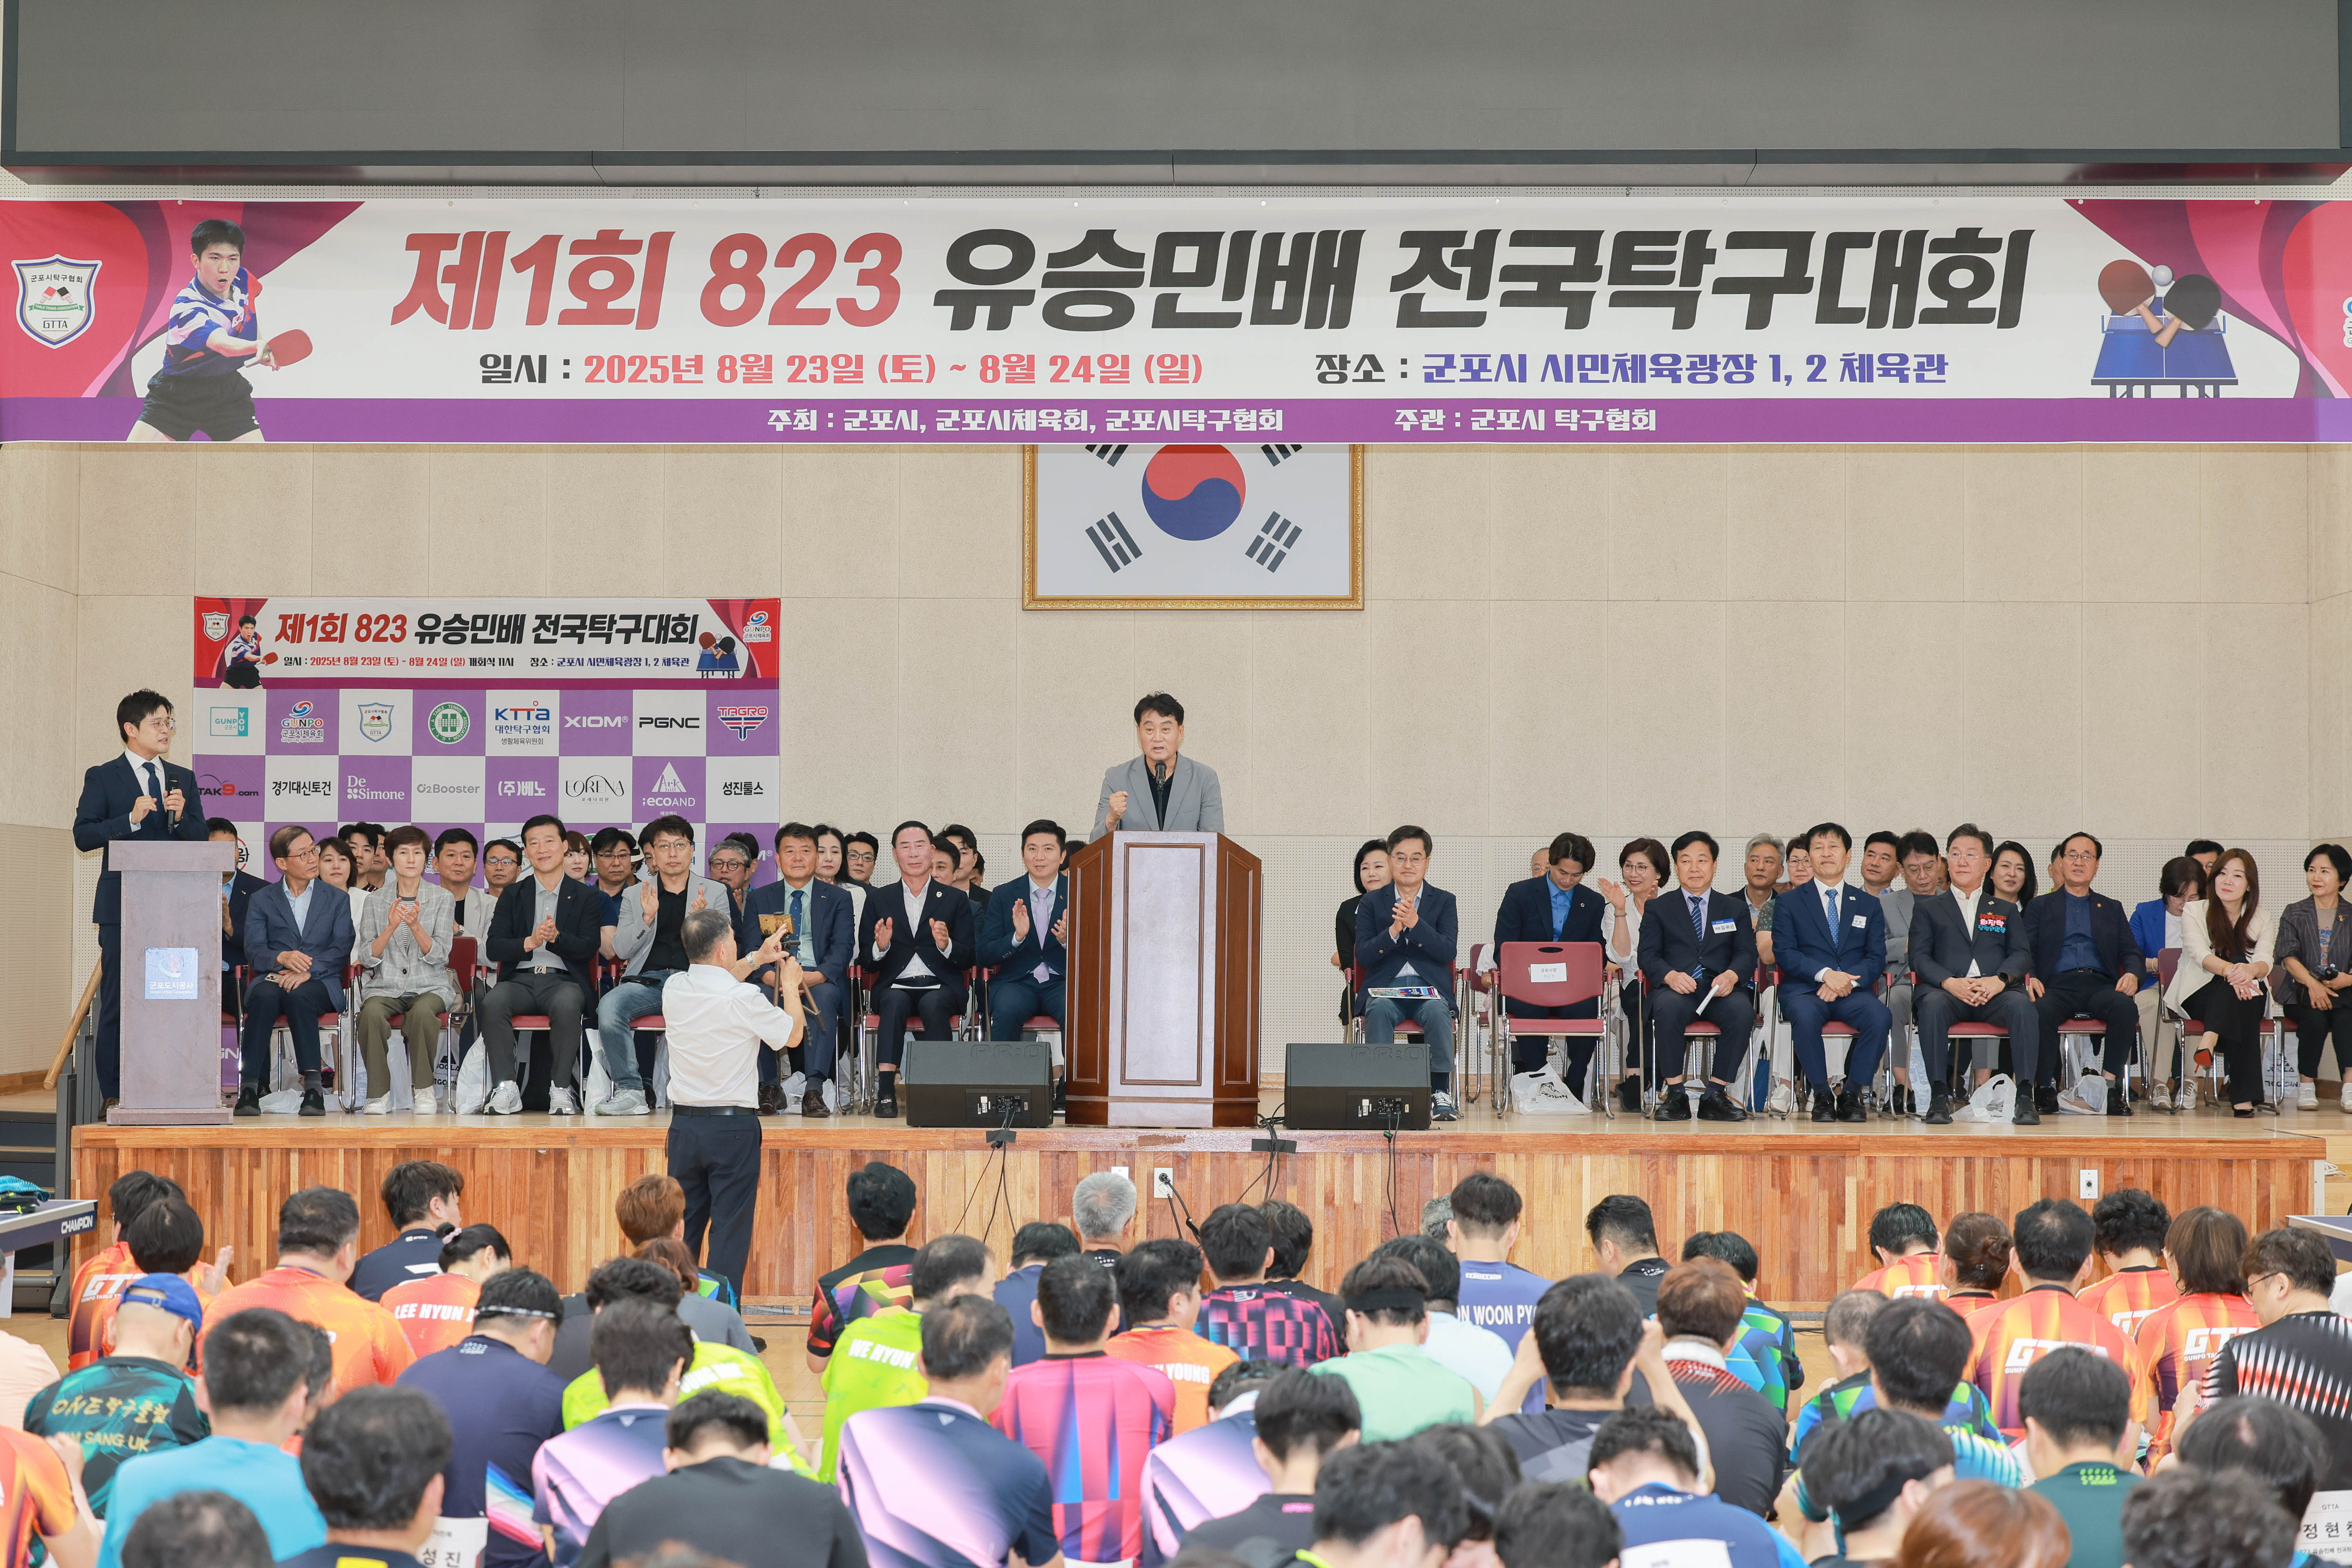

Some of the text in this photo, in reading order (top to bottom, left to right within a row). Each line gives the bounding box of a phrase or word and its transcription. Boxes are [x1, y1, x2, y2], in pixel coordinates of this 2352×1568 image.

[31, 274, 83, 283] 군포시탁구협회
[391, 227, 2036, 332] 제1회 823 유승민배 전국탁구대회
[43, 320, 68, 328] GTTA
[480, 354, 547, 383] 일시
[563, 359, 570, 379] :
[585, 355, 703, 383] 2025년
[717, 354, 773, 383] 8월
[787, 354, 863, 383] 23일
[878, 355, 935, 383] (토)
[980, 354, 1035, 383] 8월
[1049, 354, 1130, 383] 24일
[1145, 354, 1201, 383] (일)
[1316, 352, 1949, 386] 장소 : 군포시 시민체육광장 1, 2 체육관
[768, 409, 817, 431] 주최
[844, 410, 926, 433] 군포시,
[936, 409, 1096, 433] 군포시체육회,
[1106, 408, 1282, 431] 군포시탁구협회
[1395, 410, 1445, 431] 주관
[1471, 409, 1545, 430] 군포시
[1555, 408, 1656, 431] 탁구협회
[275, 613, 700, 644] 제1회 823 유승민배 전국탁구대회
[284, 657, 301, 666] 일시
[310, 657, 340, 666] 2025년
[344, 657, 358, 665] 8월
[361, 657, 381, 666] 23일
[384, 657, 398, 666] (토)
[409, 657, 423, 666] 8월
[426, 657, 447, 666] 24일
[451, 657, 465, 666] (일)
[468, 657, 495, 666] 개회식
[498, 658, 514, 666] 11시
[530, 658, 548, 667] 장소
[557, 658, 584, 666] 군포시
[587, 657, 642, 666] 시민체육광장
[645, 658, 650, 667] 1,
[653, 658, 659, 666] 2
[662, 657, 690, 666] 체육관
[433, 706, 445, 717] TABLE
[448, 704, 463, 713] TENNIS
[718, 707, 768, 716] TAGRO
[282, 719, 323, 727] GUNPO
[453, 717, 468, 741] ASSOCIATION
[495, 725, 550, 734] 대한탁구협회
[639, 717, 700, 728] PGNC
[272, 781, 331, 796] 경기대신토건
[347, 775, 366, 787] De
[498, 780, 546, 797] (주)베노
[722, 781, 764, 796] 성진툴스
[198, 784, 259, 796] TAK9.com
[359, 788, 405, 800] Simone
[61, 1215, 93, 1234] CHAMPION
[394, 1303, 418, 1319] LEE
[419, 1304, 464, 1321] HYUN
[1474, 1305, 1514, 1325] WOON
[1517, 1305, 1537, 1325] PY
[1165, 1363, 1210, 1385] YOUNG
[84, 1431, 125, 1447] SANG
[128, 1435, 151, 1452] UK
